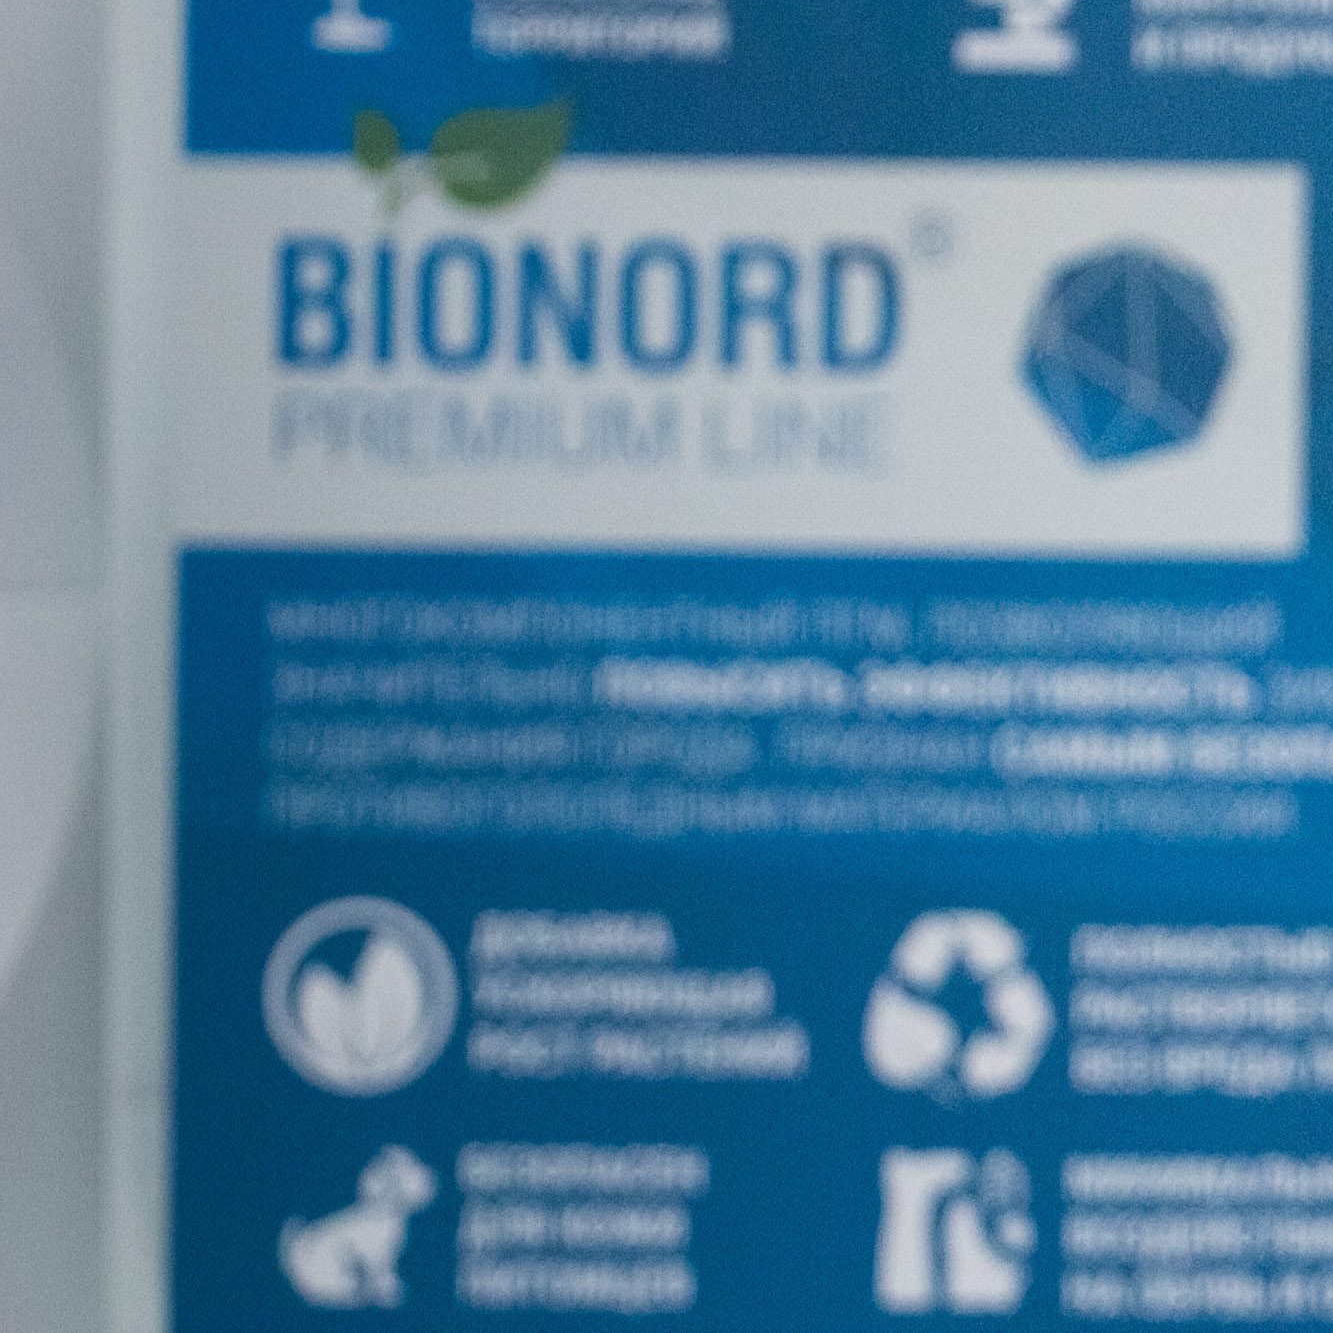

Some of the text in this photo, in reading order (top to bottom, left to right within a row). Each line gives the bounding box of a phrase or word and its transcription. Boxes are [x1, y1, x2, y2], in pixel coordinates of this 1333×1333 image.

[270, 227, 906, 378] BIONORD
[270, 394, 891, 472] PREMIUM LINE
